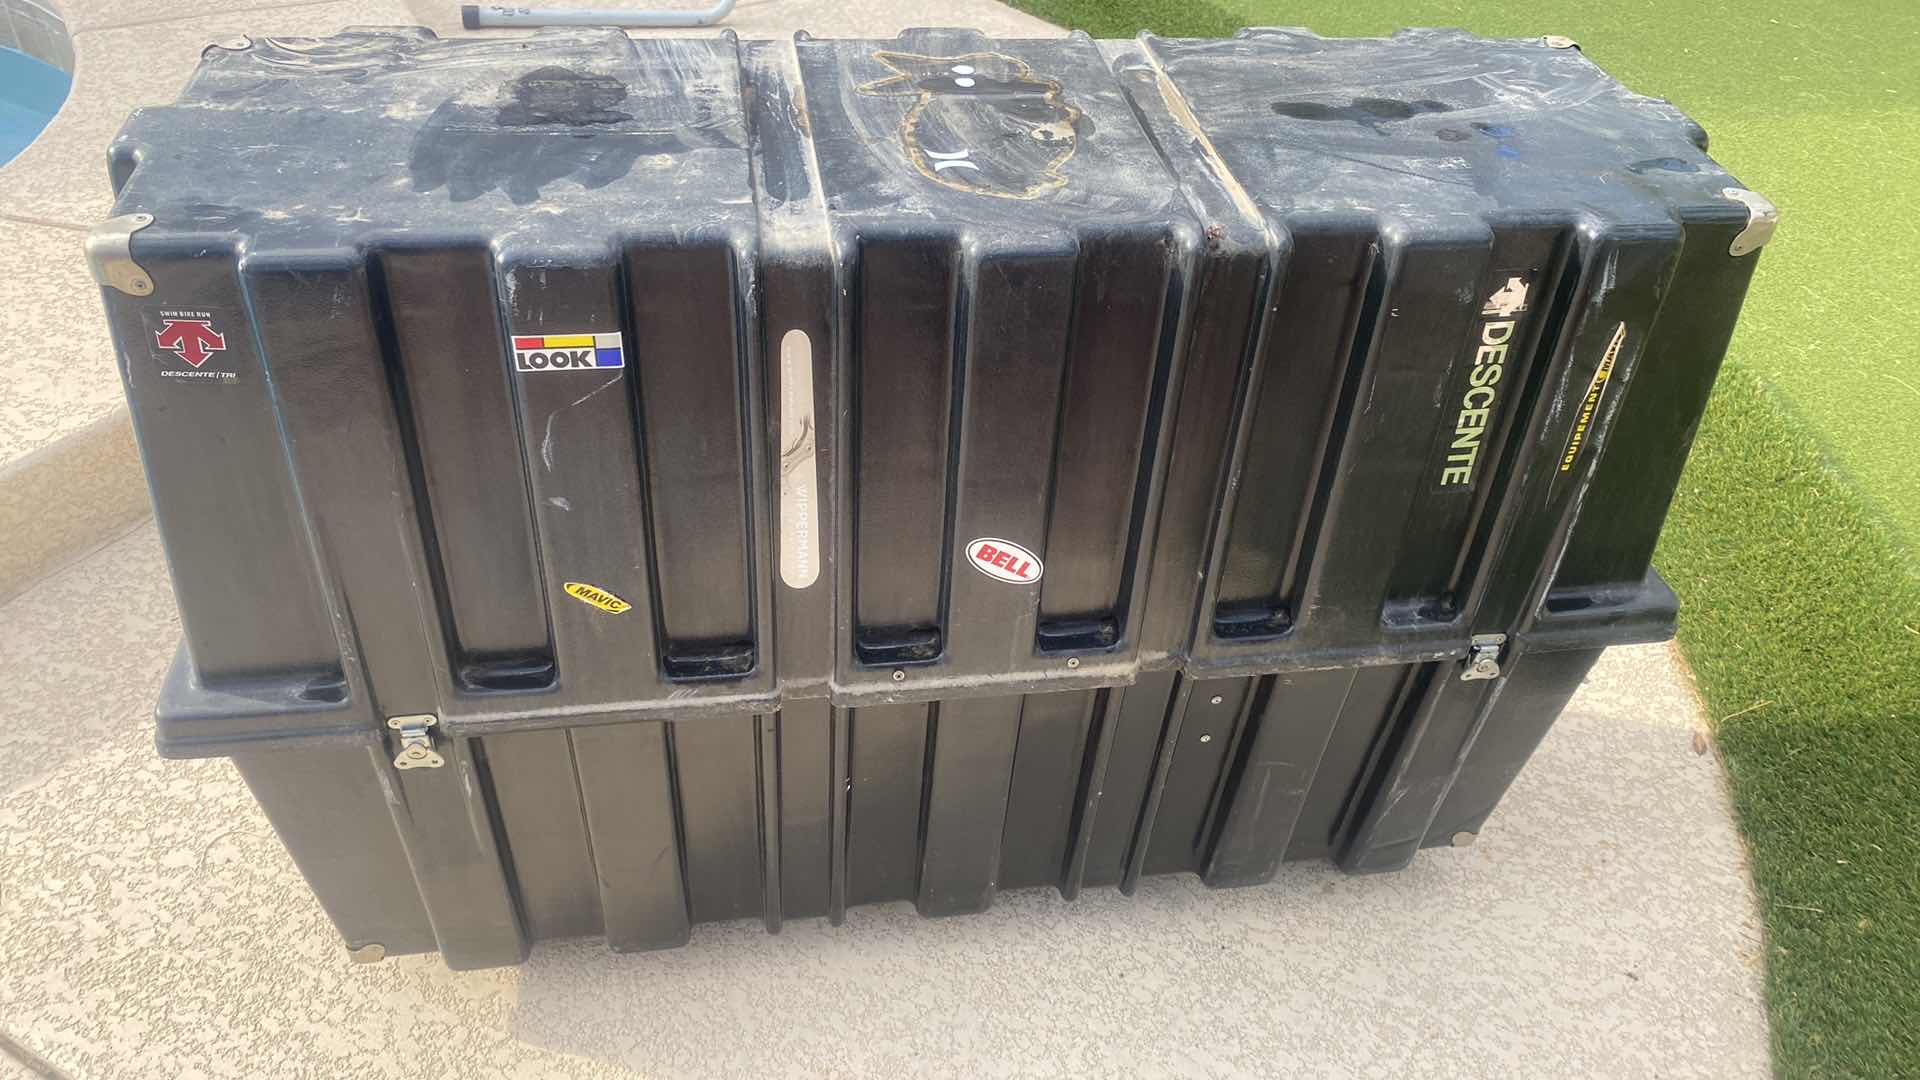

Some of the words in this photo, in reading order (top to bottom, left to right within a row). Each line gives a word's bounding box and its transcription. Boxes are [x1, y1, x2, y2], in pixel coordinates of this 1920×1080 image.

[516, 350, 593, 370] LOOK
[1440, 320, 1516, 486] DESCENTE
[1561, 383, 1603, 471] EQUIPEMENT
[976, 544, 1031, 579] BELL
[575, 586, 622, 609] MAVIC
